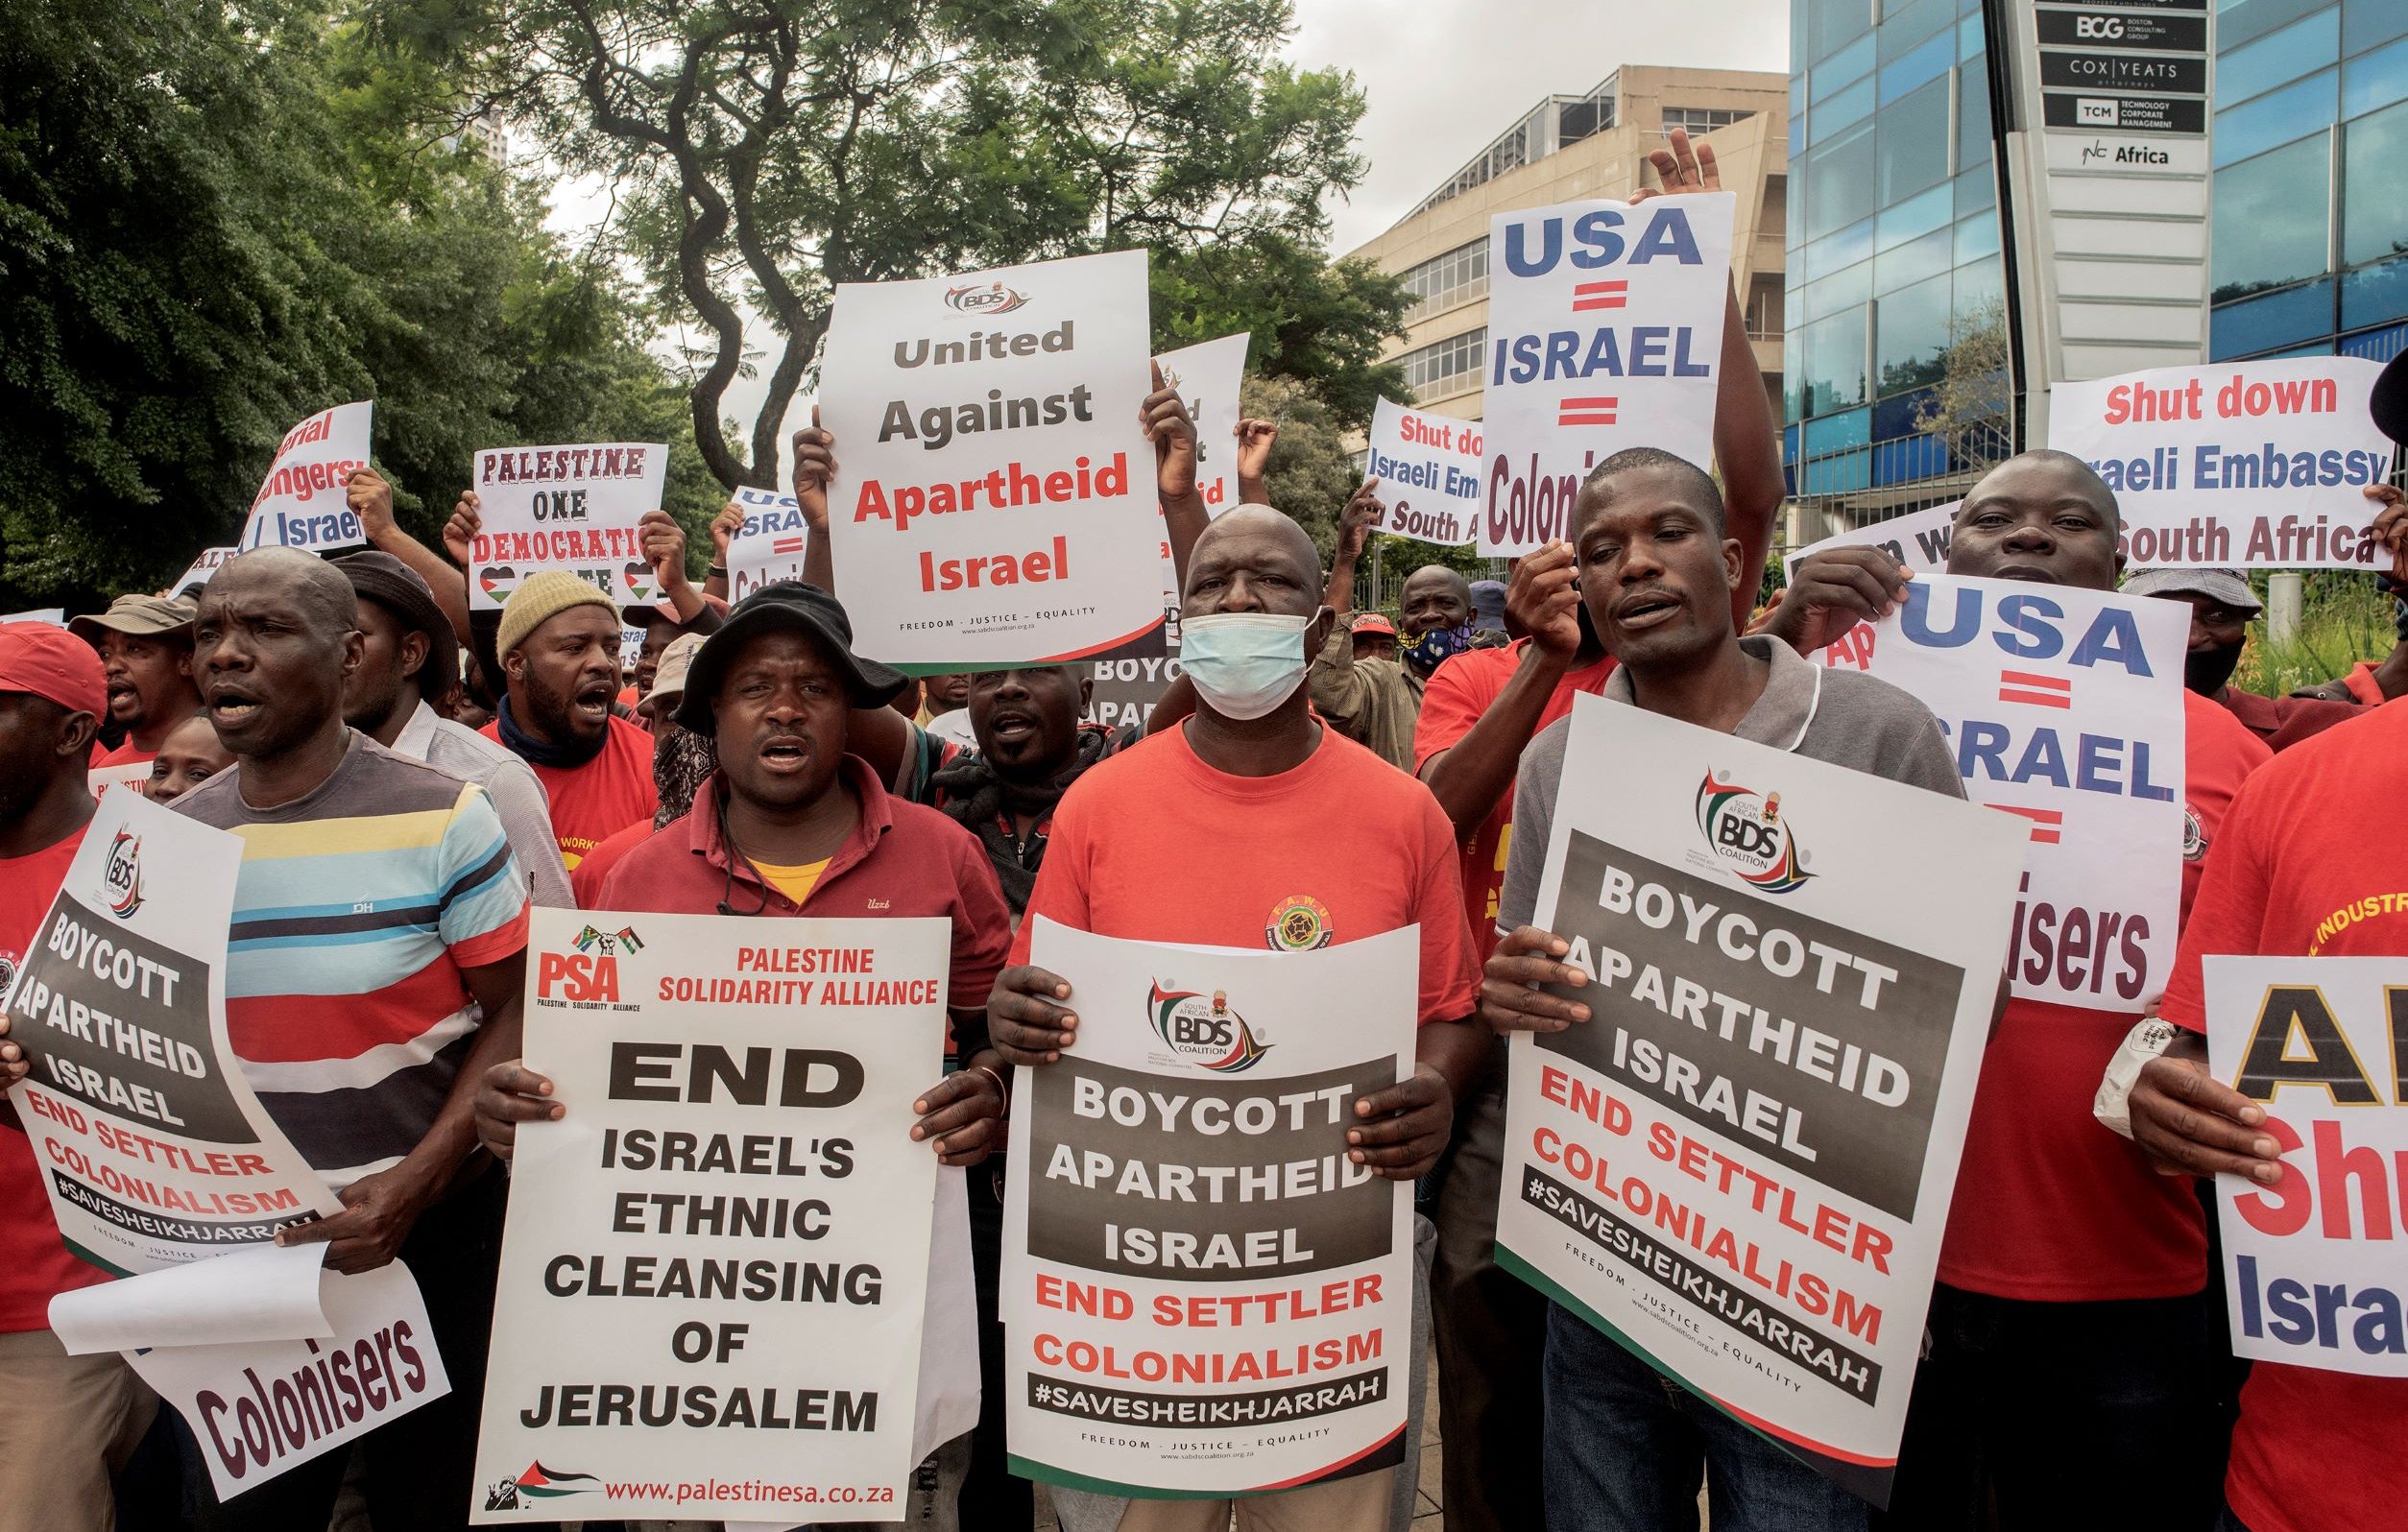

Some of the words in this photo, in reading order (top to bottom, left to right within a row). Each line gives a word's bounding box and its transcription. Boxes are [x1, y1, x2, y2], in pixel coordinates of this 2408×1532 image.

[2077, 16, 2125, 39] BCG
[2127, 26, 2166, 35] CONSULTING
[2070, 60, 2107, 75] COX
[2119, 61, 2178, 78] YEATS
[2083, 107, 2111, 118] TCM
[2121, 101, 2170, 110] TECHNOLOGY
[2121, 109, 2164, 119] CORPORATE
[2121, 119, 2172, 129] MANAGEMENT
[2115, 147, 2169, 164] Africa
[1505, 208, 1703, 277] USA
[963, 292, 1005, 307] BDS
[894, 320, 1074, 370] United
[1493, 326, 1711, 387] ISRAEL
[878, 384, 1094, 451] Against
[2104, 375, 2203, 425] Shut
[2217, 374, 2337, 420] down
[277, 411, 334, 459] erial
[1400, 415, 1452, 450] Shut
[482, 447, 647, 487] PALESTINE
[1369, 446, 1439, 491] Israeli
[1444, 466, 1481, 499] Em
[2194, 443, 2388, 490] Embassy
[532, 490, 590, 524] ONE
[853, 452, 1129, 532] Apartheid
[733, 510, 808, 541] ISRA
[1391, 500, 1459, 542] South
[2244, 515, 2376, 563] Africa
[919, 536, 1069, 593] Israel
[900, 620, 954, 631] FREEDOM
[970, 614, 1018, 625] JUSTICE
[1036, 607, 1096, 620] EQUALITY
[1899, 582, 2155, 679] USA
[1938, 717, 2175, 803] RAEL
[1728, 805, 1759, 821] AFRICAN
[1735, 800, 1758, 812] SOUTH
[1718, 812, 1779, 859] BDS
[1720, 847, 1769, 870] COALITION
[108, 855, 135, 891] BDS
[48, 911, 181, 1008] BOYCOTT
[736, 946, 875, 974] PALESTINE
[1598, 864, 1899, 1012] BOYCOTT
[538, 952, 620, 1003] PSA
[658, 976, 814, 1006] SOLIDARITY
[820, 979, 938, 1006] ALLIANCE
[14, 974, 207, 1079] APARTHEID
[537, 998, 568, 1010] PALESTINE
[572, 1000, 608, 1012] SOLIDARITY
[612, 1002, 641, 1013] ALLIANCE
[1179, 1008, 1209, 1017] AFRICAN
[1184, 1002, 1207, 1011] SOUTH
[1561, 935, 1912, 1108] APARTHEID
[1175, 1016, 1233, 1046] BDS
[1178, 1044, 1227, 1055] COALITION
[2232, 983, 2408, 1107] A
[45, 1052, 185, 1127] ISRAEL
[608, 1041, 866, 1110] END
[1612, 1027, 1818, 1162] ISRAEL
[1073, 1076, 1353, 1136] BOYCOTT
[25, 1089, 89, 1137] END
[95, 1122, 276, 1177] SETTLER
[600, 1128, 855, 1180] ISRAEL'S
[44, 1136, 301, 1215] COLONIALISM
[1046, 1143, 1375, 1204] APARTHEID
[1540, 1065, 1633, 1137] END
[1646, 1120, 1894, 1278] SETTLER
[2232, 1114, 2408, 1241] Sh
[612, 1191, 832, 1241] ETHNIC
[1532, 1126, 1884, 1348] COLONIALISM
[93, 1225, 136, 1248] FREEDOM
[149, 1247, 197, 1258] JUSTICE
[1105, 1223, 1313, 1269] ISRAEL
[543, 1254, 883, 1305] CLEANSING
[1036, 1273, 1135, 1322] END
[1152, 1274, 1384, 1328] SETTLER
[1528, 1178, 1869, 1393] #SAVESHEIKHJARRAH
[1565, 1242, 1626, 1286] FREEDOM
[1643, 1292, 1702, 1335] JUSTICE
[1722, 1341, 1803, 1394] EQUALITY
[1631, 1297, 1720, 1358] www.sabdscoalition.org.za
[2236, 1254, 2408, 1355] Isra
[671, 1321, 750, 1364] OF
[1033, 1328, 1383, 1384] COLONIALISM
[196, 1320, 426, 1480] Colonisers
[519, 1384, 879, 1433] JERUSALEM
[1035, 1376, 1380, 1423] #SAVESHEIKHJARRAH
[1081, 1432, 1150, 1449] FREEDOM
[1171, 1441, 1234, 1451] JUSTICE
[1257, 1427, 1331, 1448] EQUALITY
[1160, 1449, 1255, 1461] www.sabdscoalition.org.za
[605, 1476, 895, 1506] www.palestinesa.co.za
